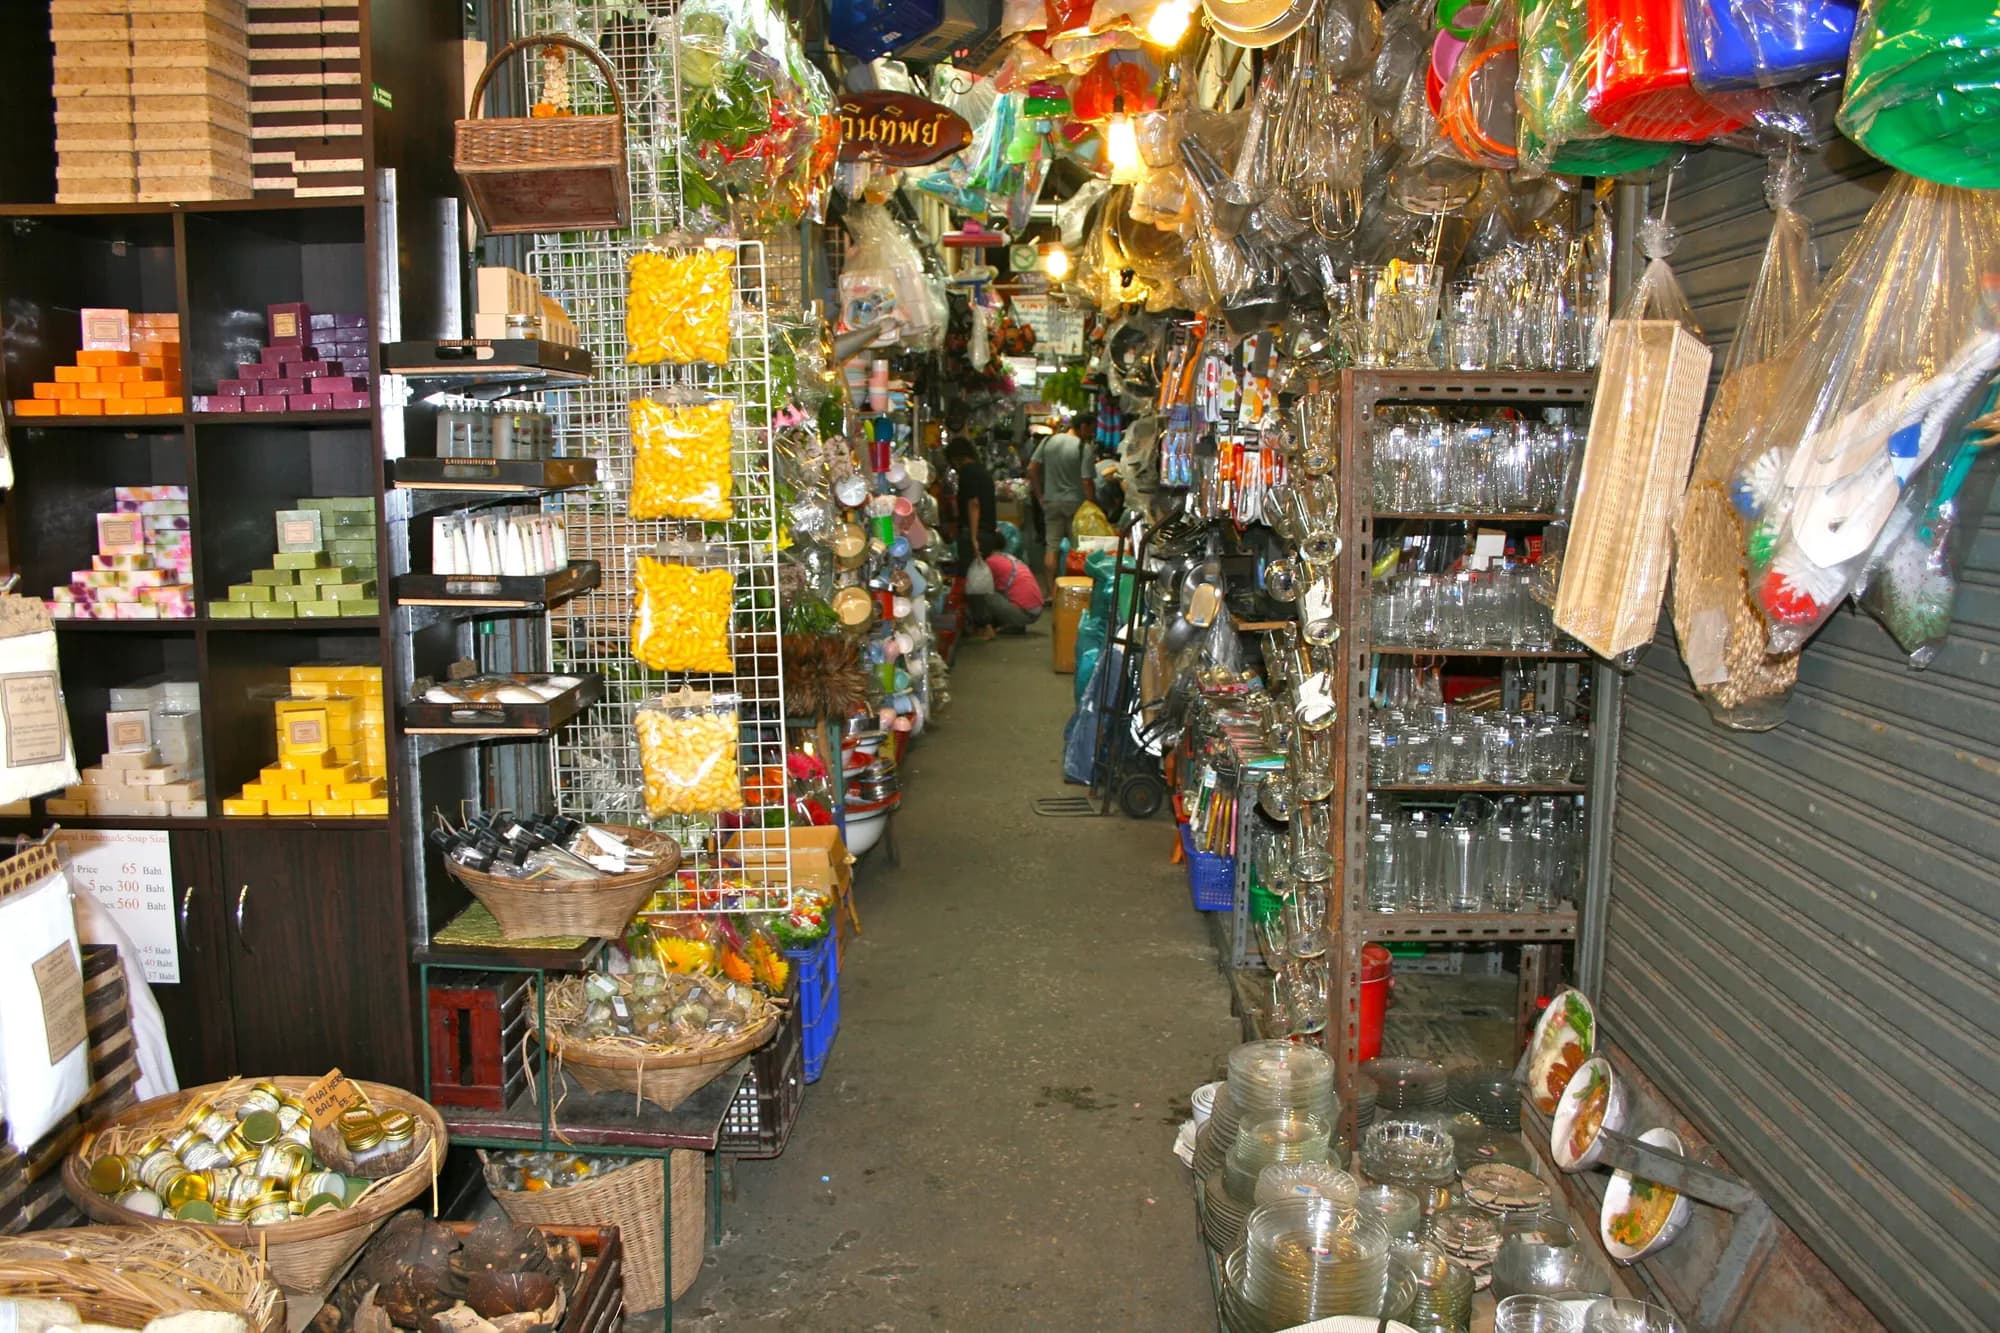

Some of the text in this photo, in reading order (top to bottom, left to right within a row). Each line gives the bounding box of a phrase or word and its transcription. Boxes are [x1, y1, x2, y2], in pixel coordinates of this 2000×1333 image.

[127, 833, 147, 844] Soap
[77, 862, 162, 875] Price 65 Baht
[88, 879, 165, 893] 5 pcs 300 Baht
[117, 898, 140, 910] 560
[147, 902, 166, 911] Baht
[307, 1086, 328, 1104] THAI
[314, 1094, 339, 1116] BALM
